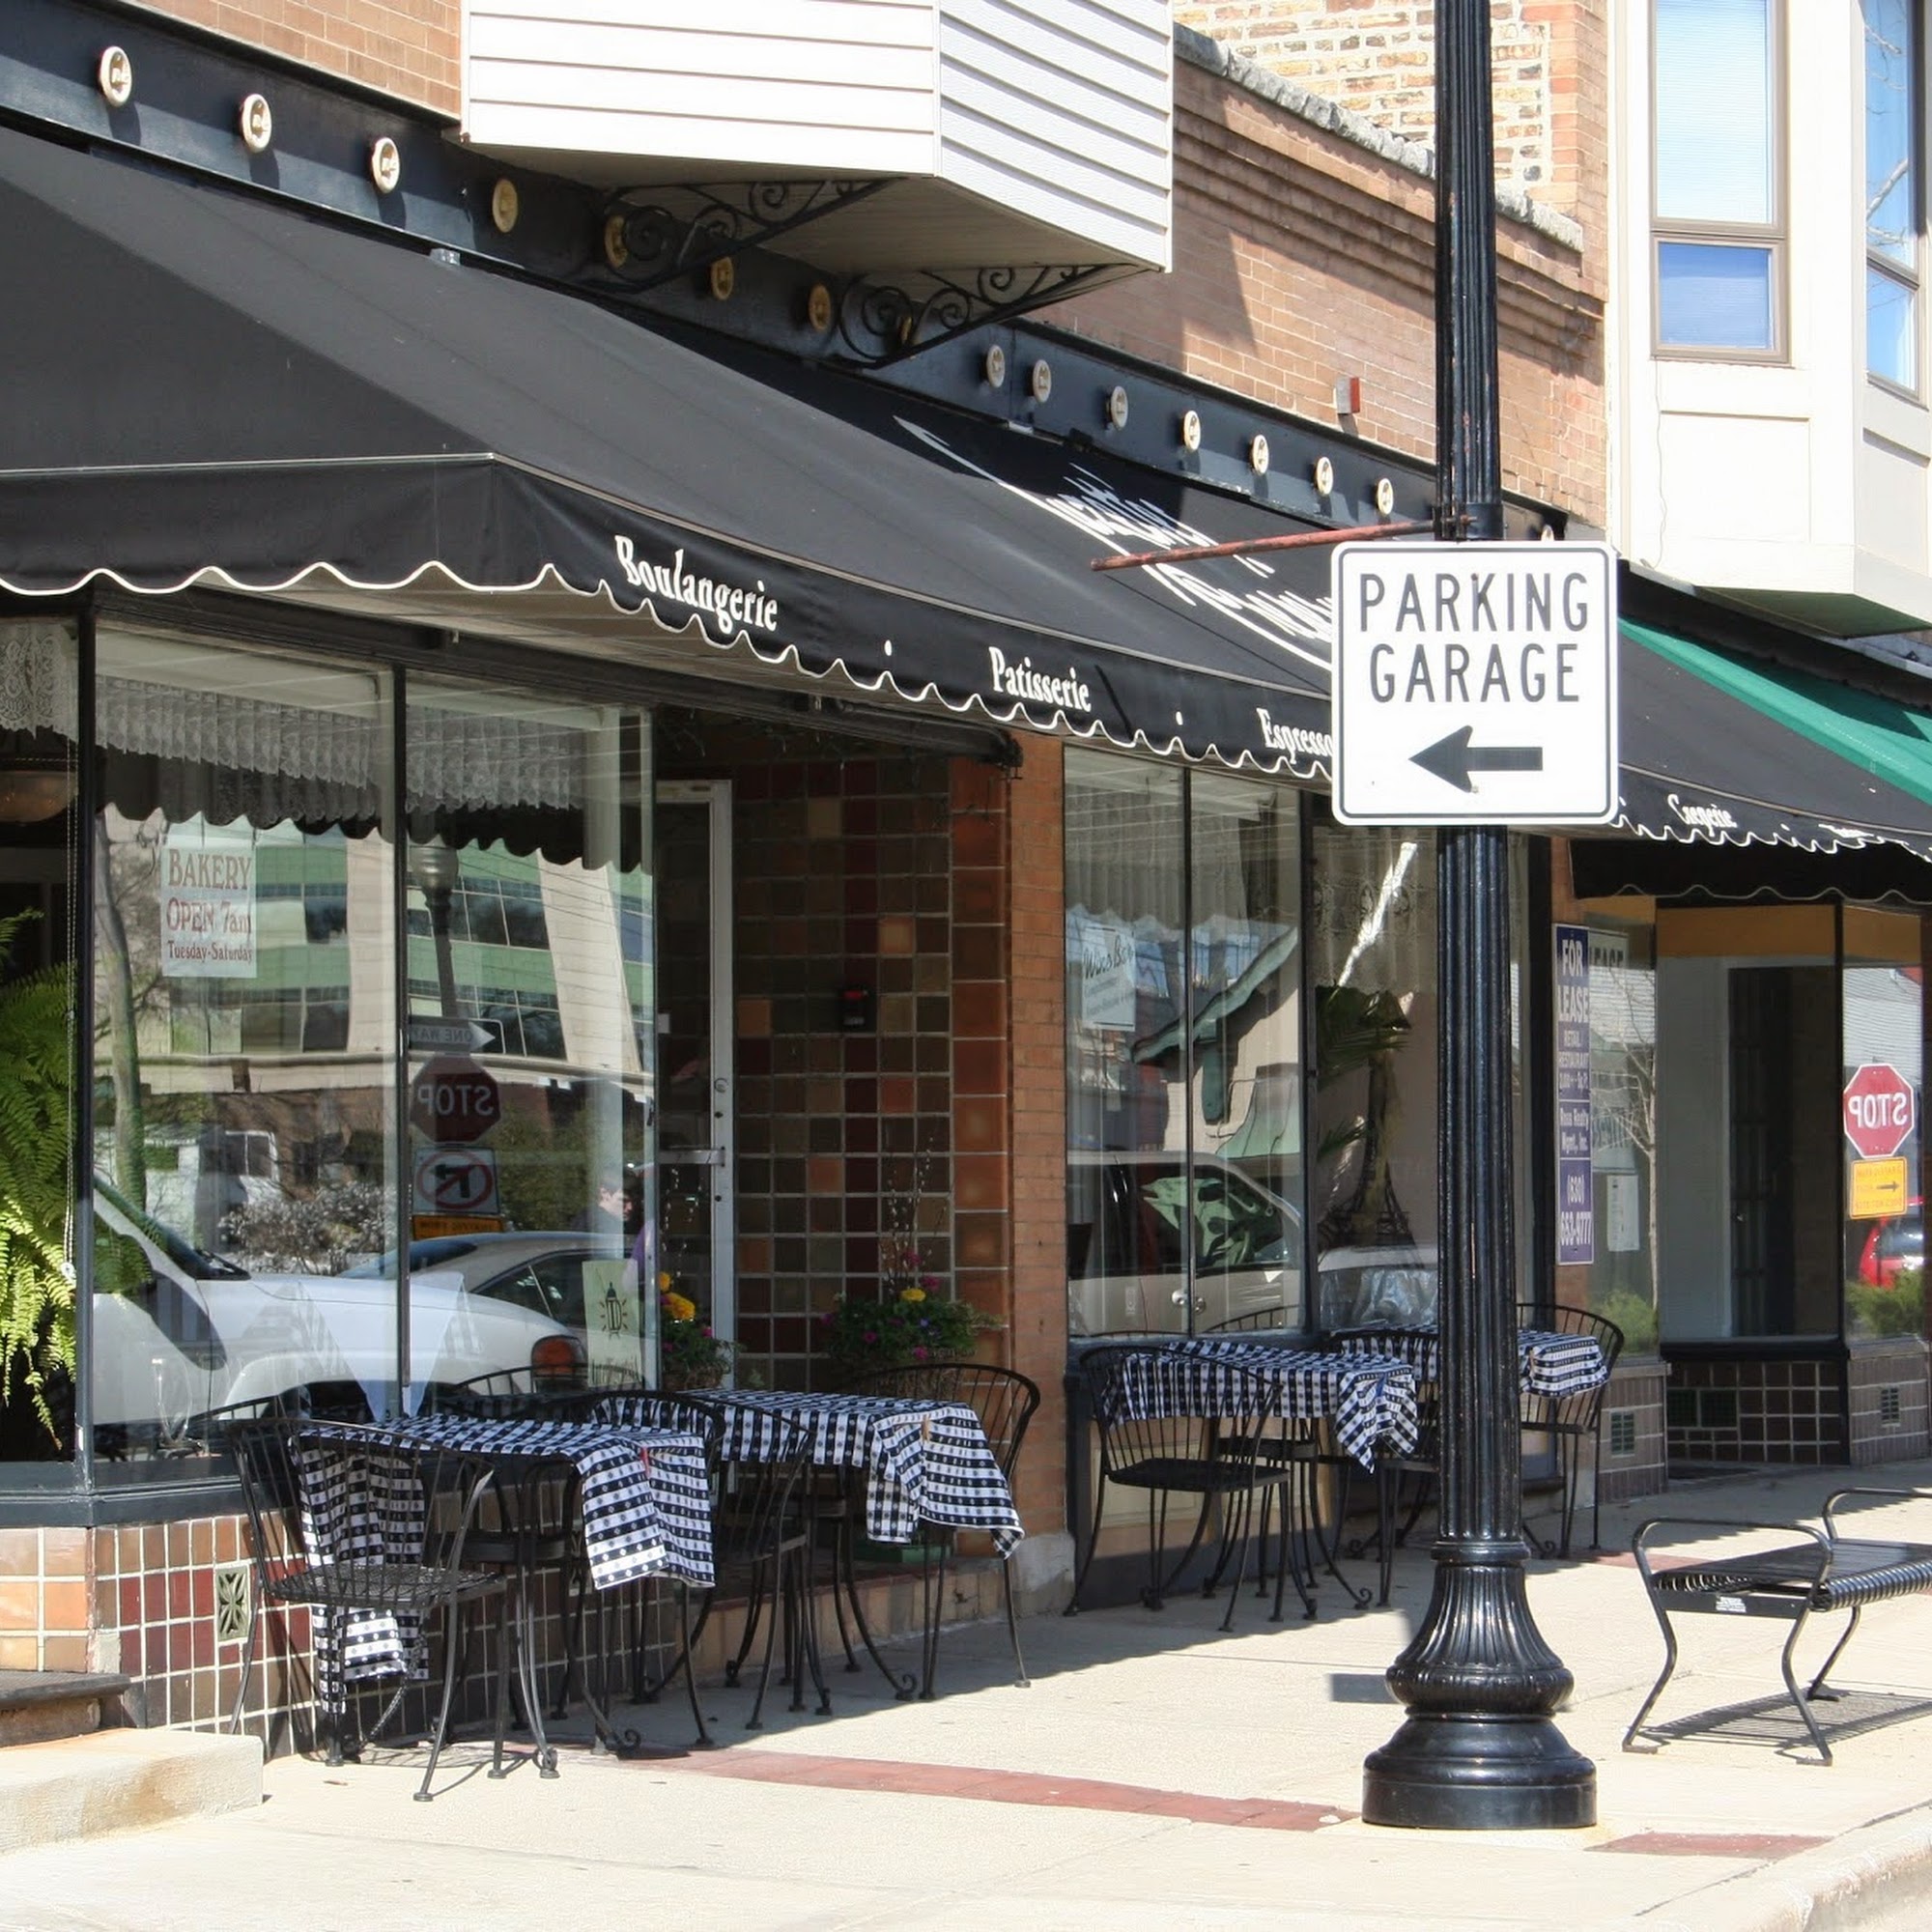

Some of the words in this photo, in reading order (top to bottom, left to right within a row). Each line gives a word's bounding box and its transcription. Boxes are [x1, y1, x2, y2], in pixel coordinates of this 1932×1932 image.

[1359, 572, 1588, 632] PARKING
[614, 535, 778, 635] Boulangerie
[988, 646, 1092, 712] Patisserie
[1256, 707, 1333, 764] Espresso
[1369, 643, 1579, 703] GARAGE
[168, 849, 252, 890] BAKERY
[166, 897, 214, 932] OPEN
[220, 901, 252, 934] 7am
[167, 940, 252, 964] Tuesday-Saturday
[1562, 939, 1583, 977] FOR
[1557, 985, 1589, 1023] LEASE
